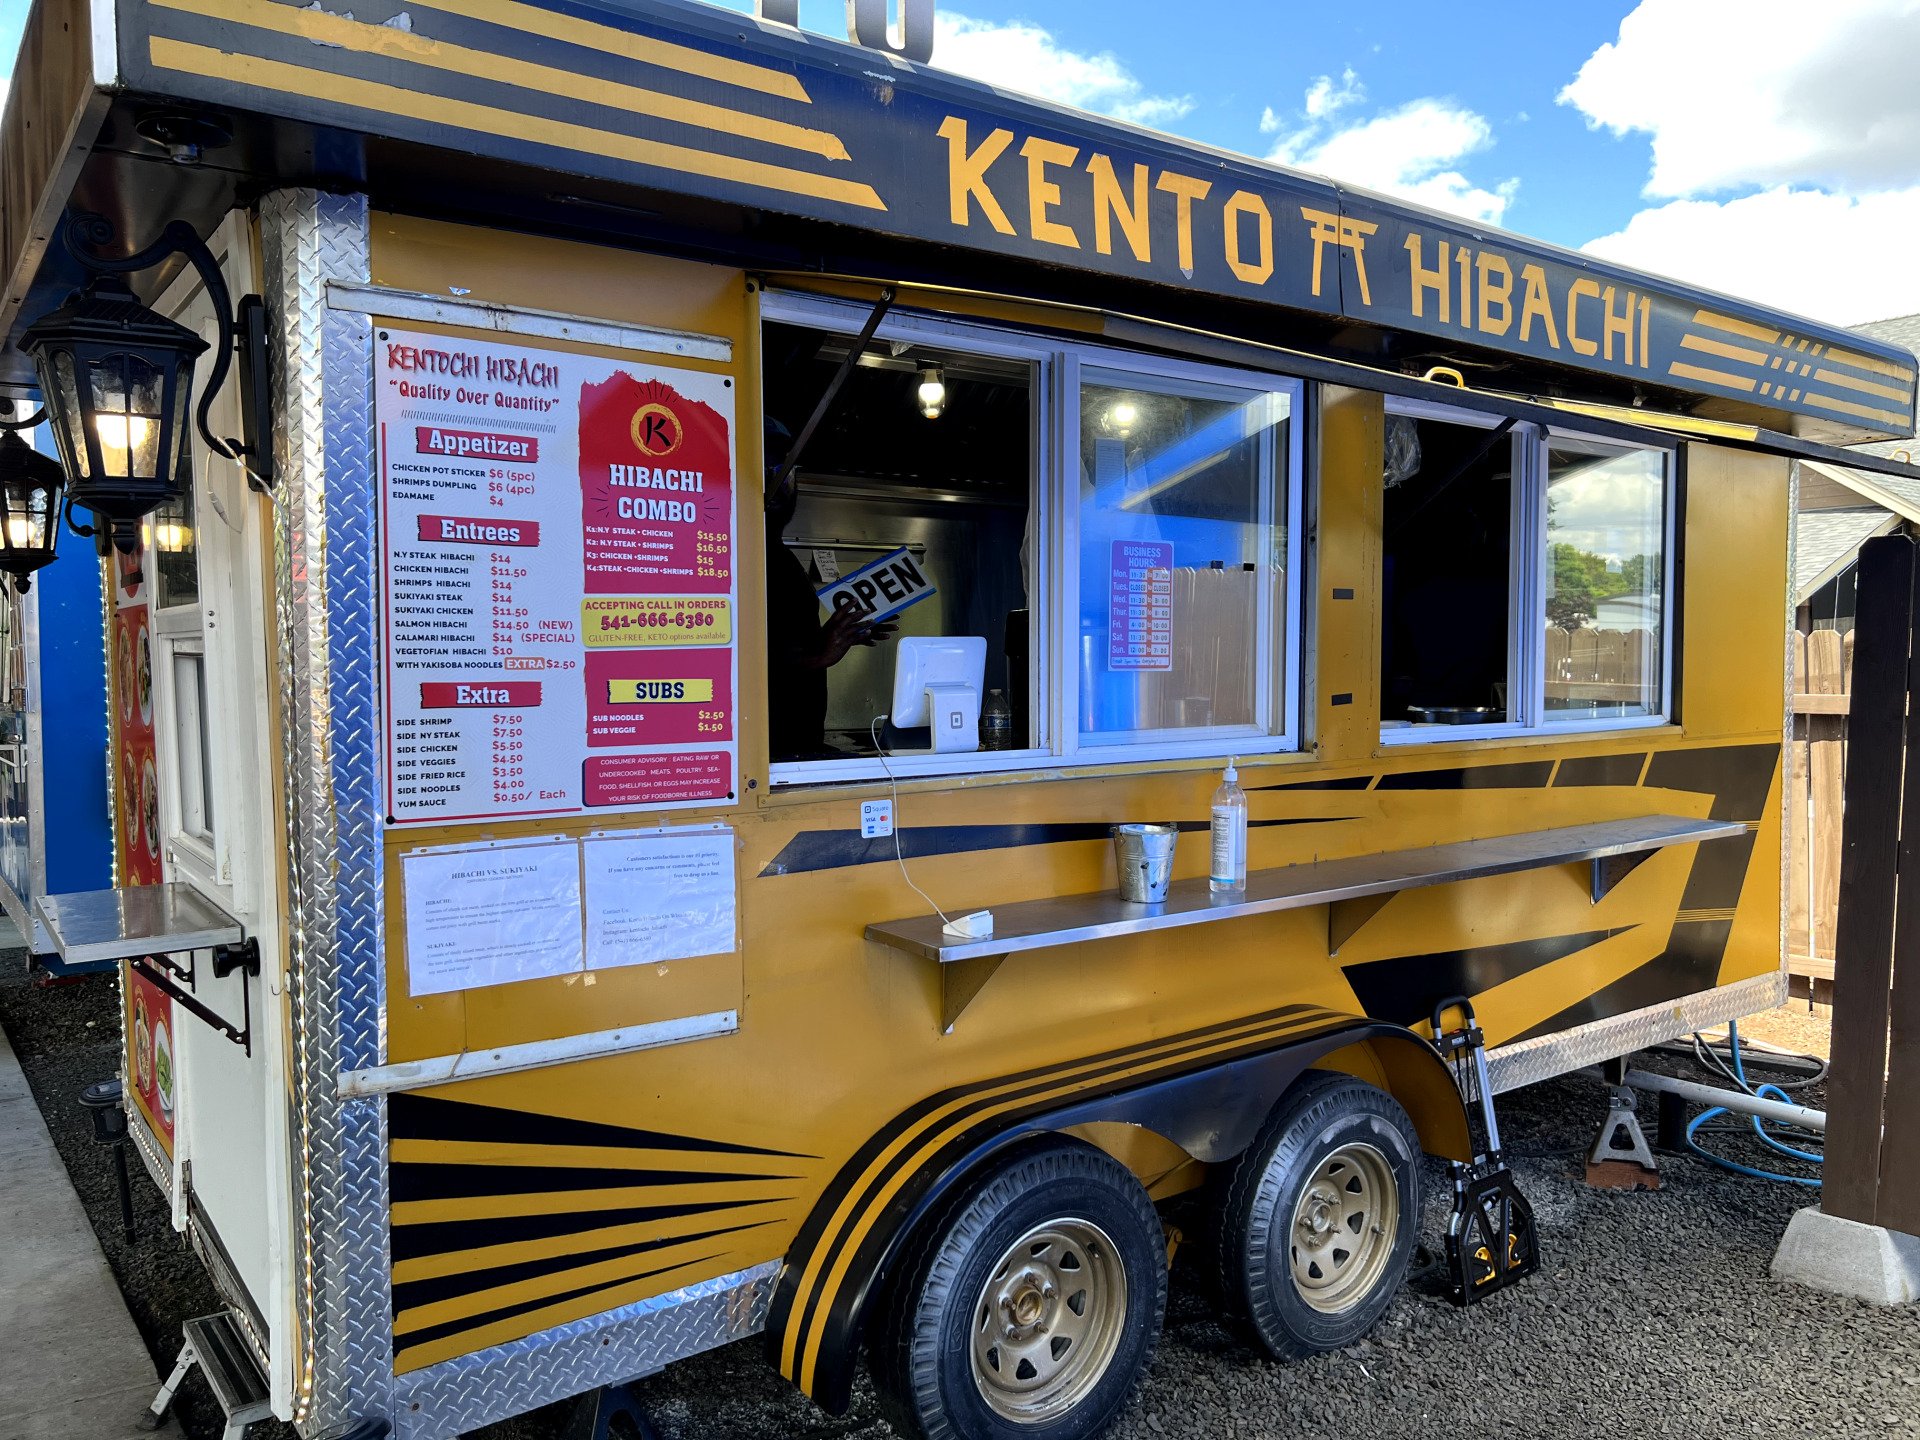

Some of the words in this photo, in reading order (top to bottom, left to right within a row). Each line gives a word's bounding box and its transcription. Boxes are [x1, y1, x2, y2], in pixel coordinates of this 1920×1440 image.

[936, 115, 1274, 285] KENTO
[1404, 232, 1651, 368] HIBACHI
[388, 344, 479, 378] KENTOCHI
[486, 356, 558, 388] HIBACHI
[456, 388, 489, 405] Over
[646, 416, 671, 447] K
[429, 430, 529, 457] Appetizer
[392, 464, 430, 473] CHICKEN
[451, 468, 486, 478] STICKER
[489, 469, 503, 479] $6
[506, 471, 535, 482] (5pc)
[609, 463, 703, 493] HIBACHI
[392, 478, 430, 487] SHRIMPS
[432, 481, 477, 490] DUMPLING
[489, 483, 503, 493] $6
[506, 484, 535, 495] (4pc)
[392, 491, 435, 501] EDAMAME
[490, 496, 504, 507] $4
[618, 497, 696, 523] COMBO
[441, 520, 520, 542] Entrees
[697, 530, 728, 542] $15.50
[613, 540, 636, 548] STEAK
[642, 542, 674, 550] SHRIMPS
[697, 543, 727, 553] $16.50
[1124, 546, 1161, 557] BUSINESS
[440, 553, 475, 561] HIBACHI
[491, 553, 510, 564] $14
[600, 552, 632, 560] CHICKEN
[697, 555, 714, 566] $15
[1128, 558, 1156, 568] HOURS:
[394, 565, 432, 573] CHICKEN
[434, 566, 468, 574] HIBACHI
[491, 566, 526, 577] $11.50
[697, 567, 728, 578] $18.50
[1113, 569, 1128, 578] Mon.
[492, 580, 511, 590] $14
[832, 556, 927, 614] OPEN
[1113, 582, 1128, 590] Tues.
[492, 593, 512, 604] $14
[492, 606, 528, 617] $11.50
[585, 601, 644, 610] ACCEPTING
[647, 601, 672, 609] CALL
[674, 601, 685, 609] IN
[687, 601, 726, 609] ORDERS
[1112, 607, 1127, 615] Thur.
[493, 619, 529, 630] $14.50
[538, 620, 573, 630] (NEW)
[600, 612, 714, 631] 541-666-6380
[493, 632, 513, 644] $14
[521, 633, 575, 643] (SPECIAL)
[669, 633, 694, 642] options
[493, 646, 513, 656] $10
[1112, 645, 1125, 653] Sun.
[507, 660, 544, 668] EXTRA
[546, 659, 575, 670] $2.50
[457, 686, 510, 704] Extra
[636, 682, 684, 699] SUBS
[420, 718, 452, 726] SHRIMP
[493, 714, 522, 725] $7.50
[698, 710, 724, 719] $2.50
[493, 728, 522, 738] $7.50
[698, 722, 723, 733] $1.50
[397, 746, 416, 754] SIDE
[420, 745, 458, 753] CHICKEN
[492, 740, 523, 751] $5.50
[420, 758, 456, 766] VEGGIES
[492, 754, 523, 764] $4.50
[420, 772, 445, 780] FRIED
[493, 767, 523, 777] $3.50
[599, 770, 646, 778] UNDERCOOKED
[420, 785, 461, 793] NOODLES
[493, 780, 524, 790] $4.00
[419, 799, 446, 807] SAUCE
[540, 789, 566, 800] Each
[452, 870, 485, 879] HIBACHI
[487, 868, 498, 876] VS.
[500, 866, 538, 874] SUKIYAKI
